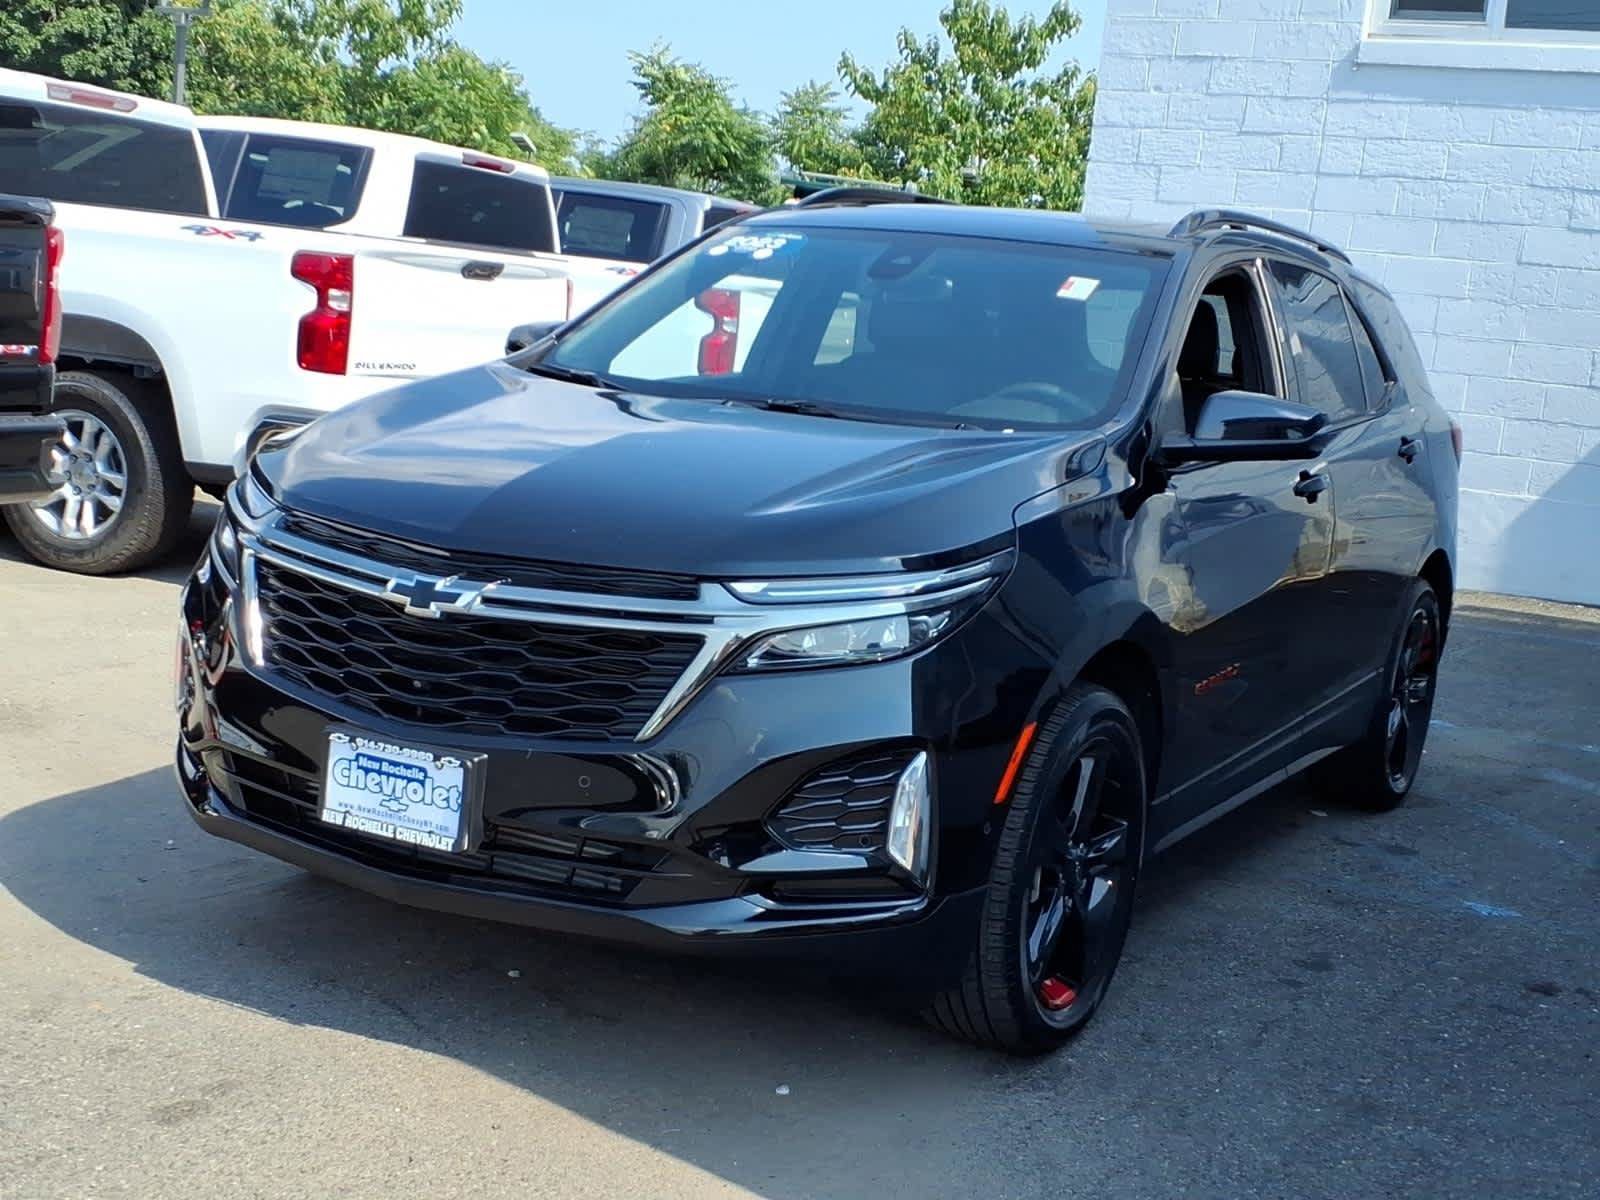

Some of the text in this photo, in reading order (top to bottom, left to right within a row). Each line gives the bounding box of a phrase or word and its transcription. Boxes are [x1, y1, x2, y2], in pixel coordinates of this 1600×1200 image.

[359, 757, 426, 780] New Rochelle
[333, 758, 463, 812] Chevrolet
[322, 808, 344, 825] NEW
[345, 814, 395, 838] ROCHELLE
